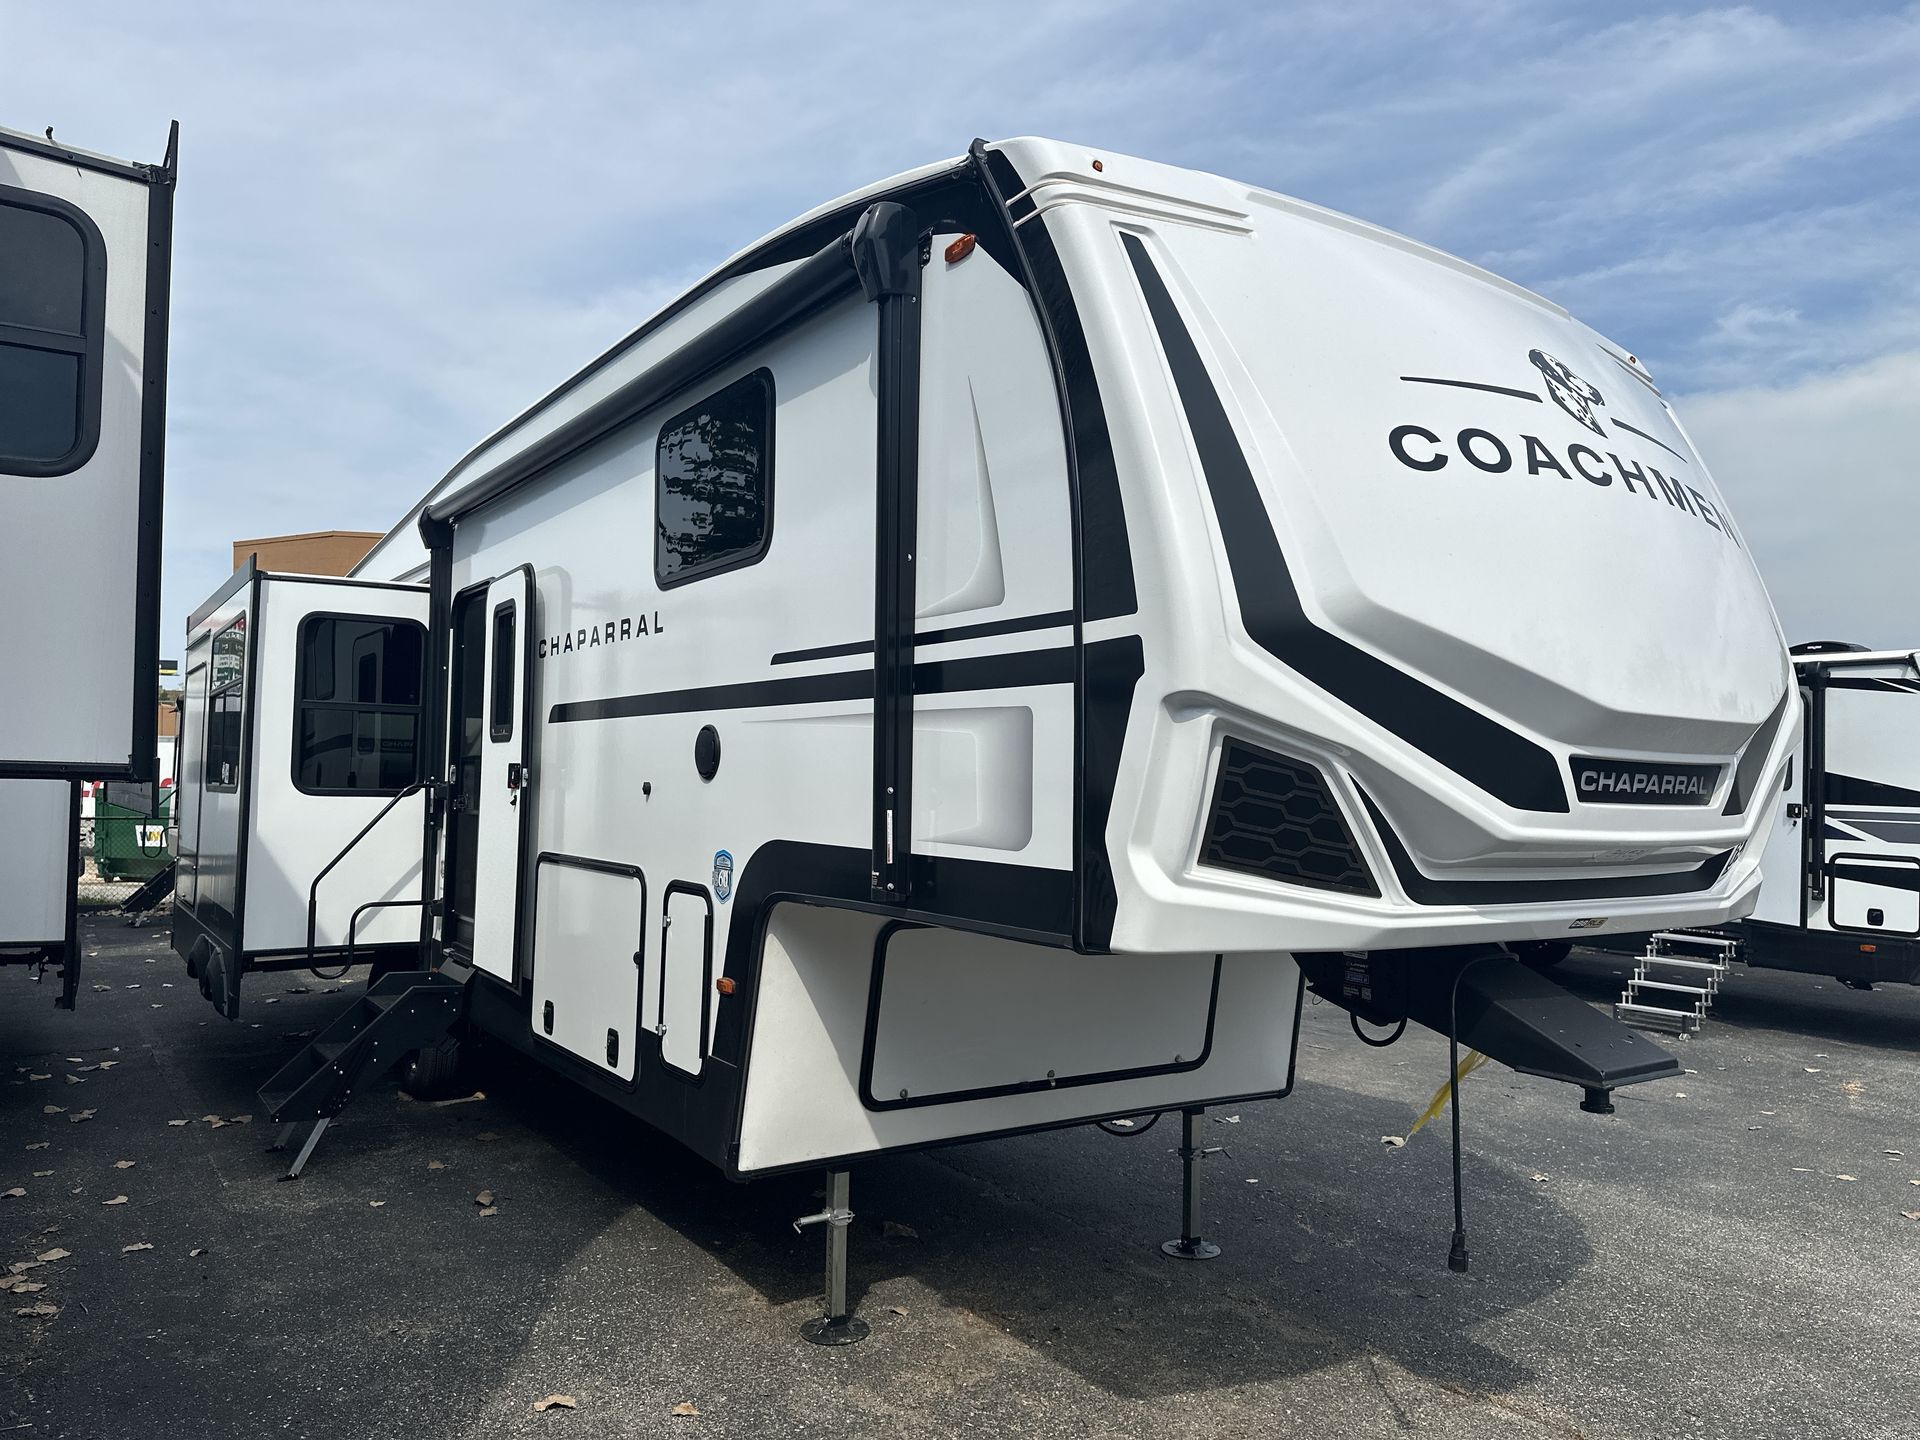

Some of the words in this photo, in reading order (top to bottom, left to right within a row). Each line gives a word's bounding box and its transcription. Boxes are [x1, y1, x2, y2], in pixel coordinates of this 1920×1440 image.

[1388, 424, 1742, 550] COACHMEN
[538, 610, 664, 659] CHAPARRAL
[1580, 770, 1707, 795] CHAPARRAL
